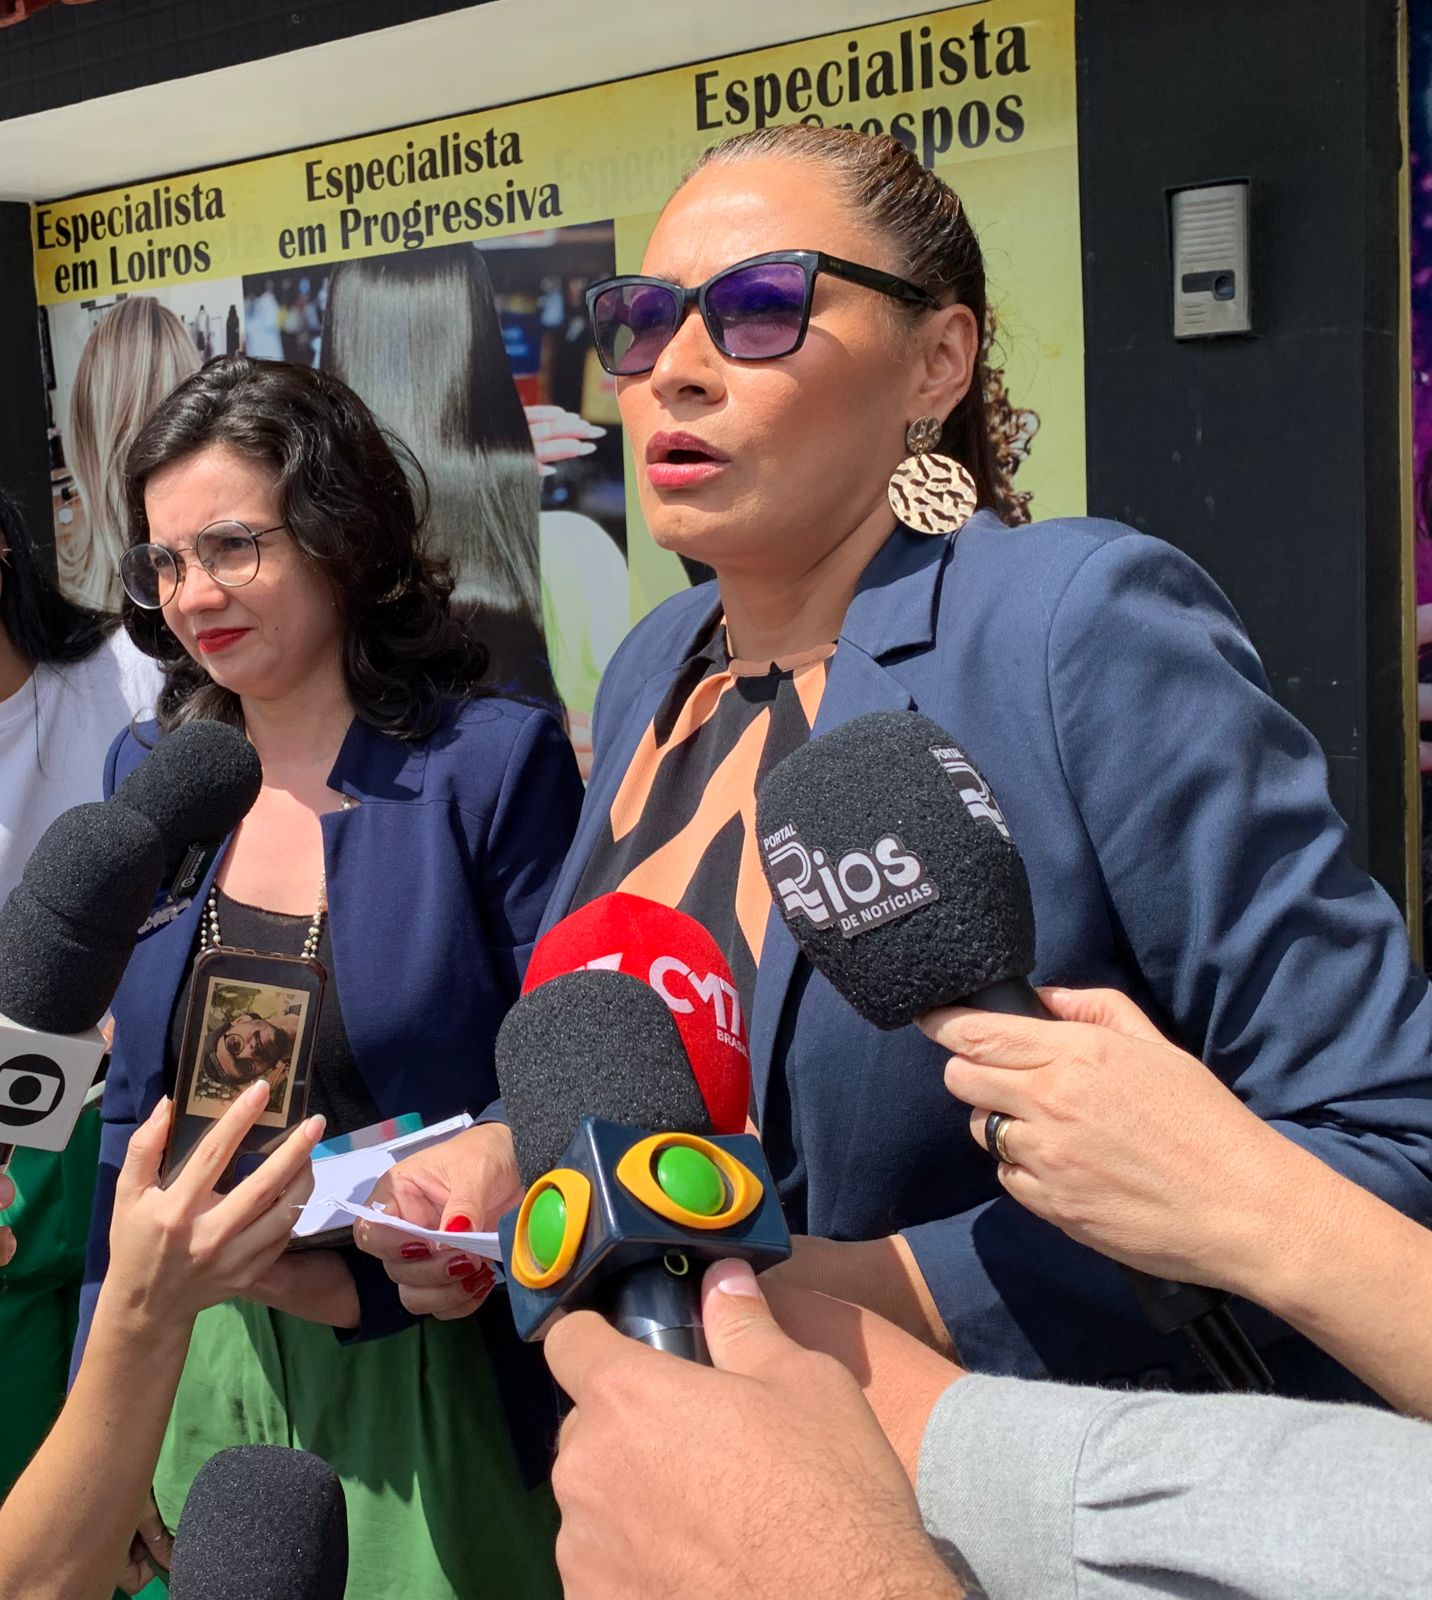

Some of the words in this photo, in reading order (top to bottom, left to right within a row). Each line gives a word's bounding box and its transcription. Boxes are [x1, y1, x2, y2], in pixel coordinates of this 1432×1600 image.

[695, 18, 1031, 132] Especialista
[305, 127, 523, 205] Especialista
[800, 93, 1026, 169] spos
[36, 181, 226, 254] Especialista
[278, 221, 327, 260] em
[340, 178, 564, 251] Progressiva
[54, 258, 98, 294] em
[109, 238, 212, 286] Loiros
[763, 823, 798, 852] PORTAL
[840, 914, 860, 932] DE
[862, 882, 933, 923] NOTÍCIAS
